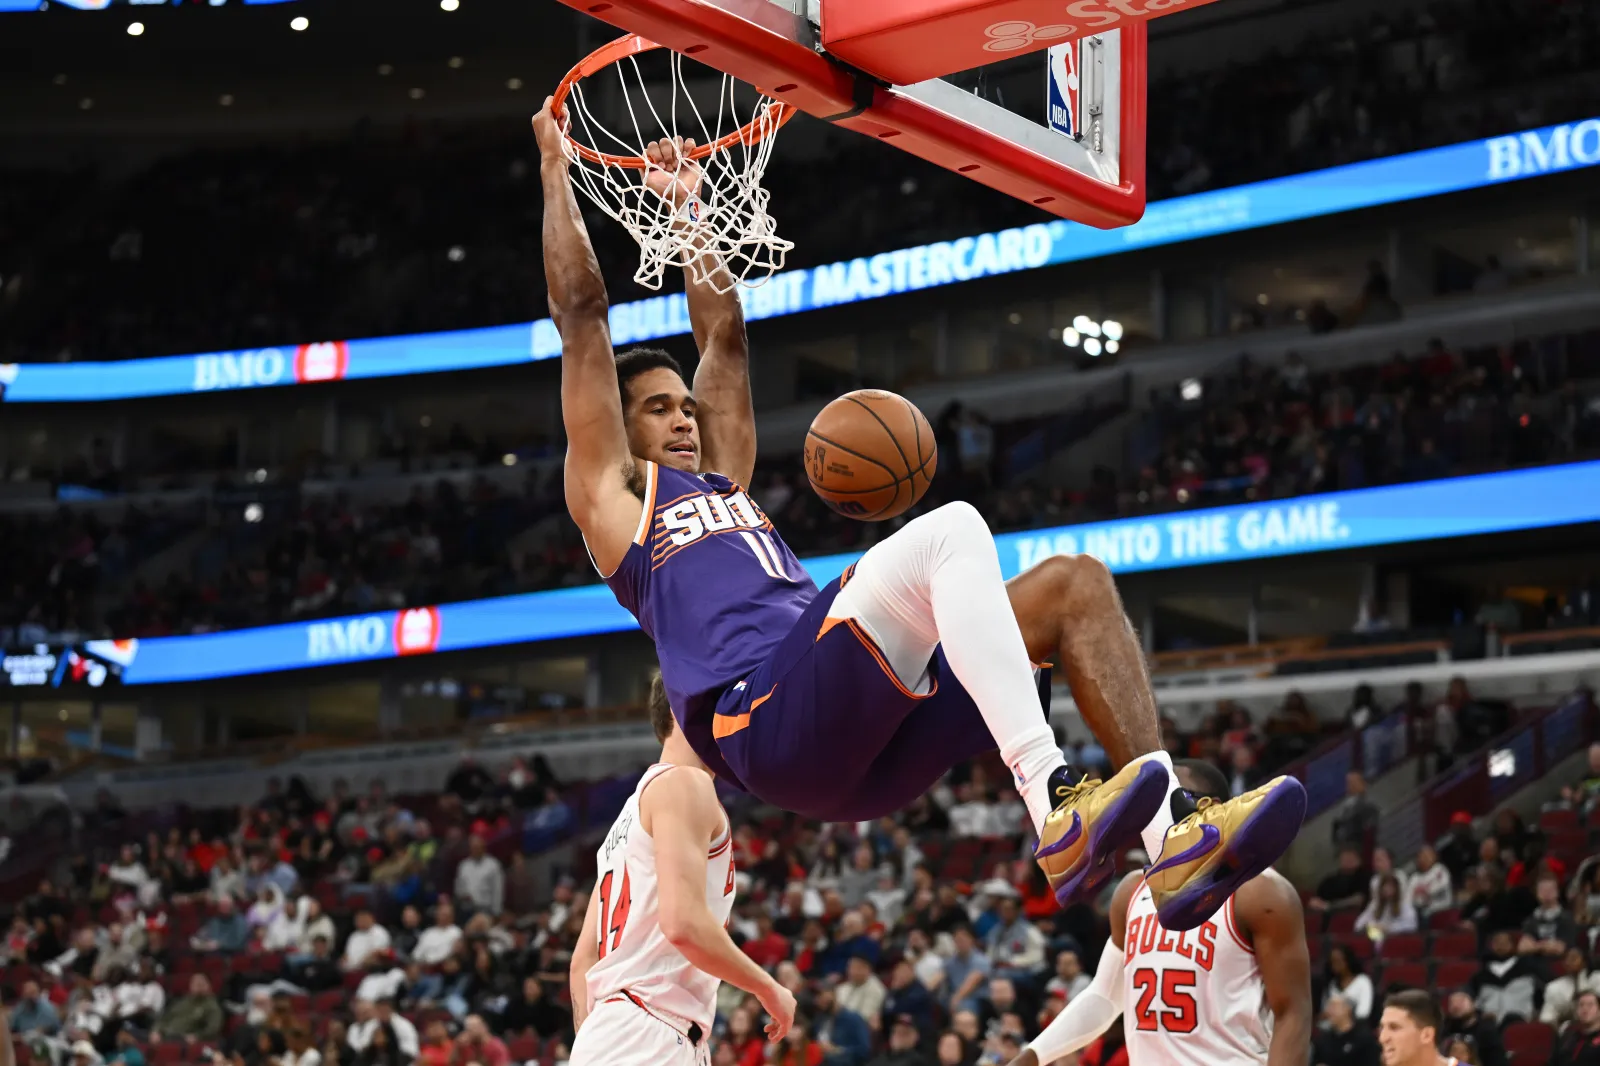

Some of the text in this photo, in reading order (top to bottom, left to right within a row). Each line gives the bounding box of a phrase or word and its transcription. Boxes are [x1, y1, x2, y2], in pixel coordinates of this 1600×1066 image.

[1052, 103, 1068, 129] NBA
[1485, 118, 1600, 181] BMO
[738, 269, 808, 321] EBIT
[662, 491, 767, 546] SUN
[1167, 513, 1230, 560] THE
[1236, 501, 1351, 551] GAME.
[738, 530, 798, 583] 11
[599, 860, 632, 961] 14
[1124, 912, 1218, 972] BULLS
[1132, 967, 1198, 1033] 25
